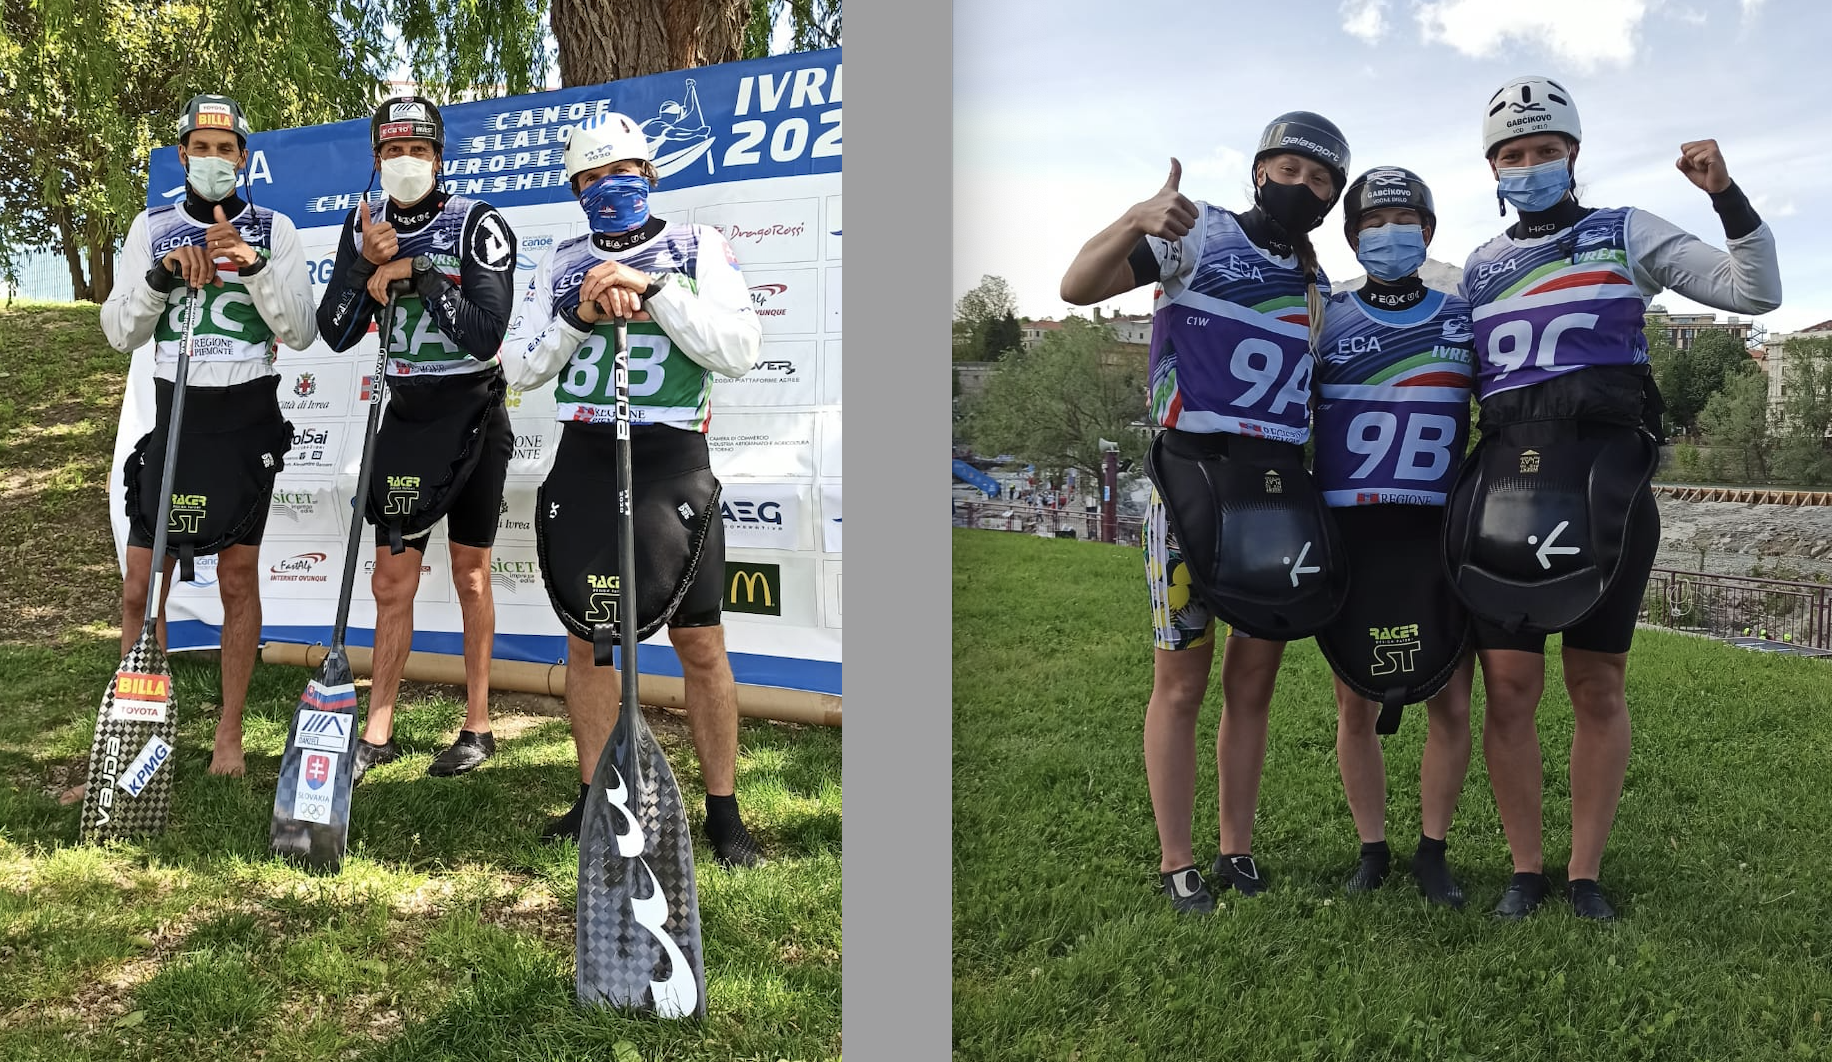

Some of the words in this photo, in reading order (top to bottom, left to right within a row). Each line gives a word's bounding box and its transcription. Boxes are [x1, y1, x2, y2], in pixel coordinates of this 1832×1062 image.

[198, 114, 231, 127] BILLA
[496, 99, 611, 131] CANOE
[471, 124, 574, 153] SLALO
[1280, 135, 1340, 162] galasport
[443, 149, 566, 176] UROPE
[161, 235, 193, 249] ECA
[730, 222, 804, 244] DragoRossi
[522, 238, 553, 247] canoe
[1229, 254, 1264, 283] ECA
[1478, 258, 1517, 279] ECA
[560, 272, 584, 288] EC
[169, 286, 252, 333] 8C
[755, 308, 787, 316] VUNQUE
[1186, 316, 1210, 327] C1W
[194, 338, 233, 347] REGIONE
[194, 347, 234, 356] PIEMONTE
[1338, 336, 1382, 354] ECA
[1487, 312, 1600, 383] 9C
[1431, 345, 1471, 363] IVRE
[562, 334, 671, 398] 8B
[1229, 338, 1315, 420] 9A
[297, 400, 306, 409] di
[308, 400, 330, 410] Ivrea
[594, 408, 646, 418] REGNE
[292, 428, 328, 445] olSai
[1346, 411, 1457, 481] 9B
[387, 476, 421, 487] RACER
[171, 493, 207, 507] RACER
[384, 490, 419, 514] ST
[168, 508, 207, 533] ST
[721, 501, 782, 525] AEG
[505, 519, 530, 530] Ivrea
[280, 560, 312, 573] FastAlp
[587, 574, 620, 589] RAC
[1369, 623, 1419, 640] RACER
[1370, 640, 1421, 676] ST
[118, 677, 166, 697] BILLA
[122, 707, 158, 717] TOYOTA
[128, 743, 169, 796] KPMG
[298, 792, 330, 803] SLOVAKIA
